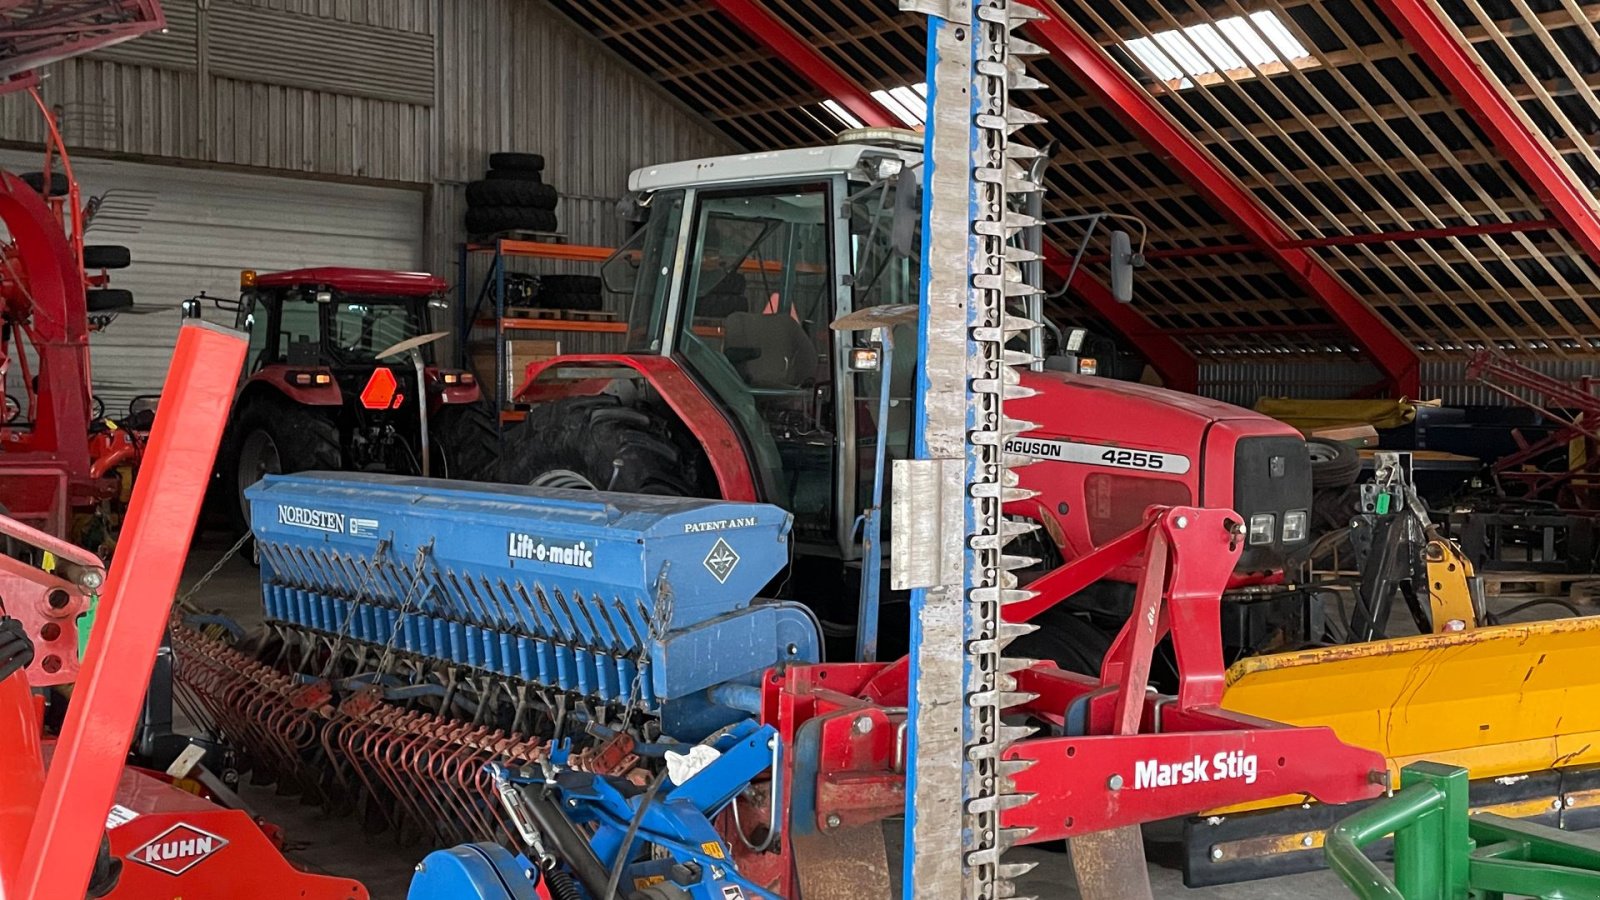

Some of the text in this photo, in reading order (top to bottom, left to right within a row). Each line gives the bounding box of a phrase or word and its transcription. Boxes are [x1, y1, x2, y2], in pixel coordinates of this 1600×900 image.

[1101, 449, 1164, 469] 4255
[278, 504, 345, 534] NORDSTEN
[684, 520, 727, 533] PATENT
[1135, 749, 1258, 790] Marsk Stig
[145, 836, 213, 863] KUHN
